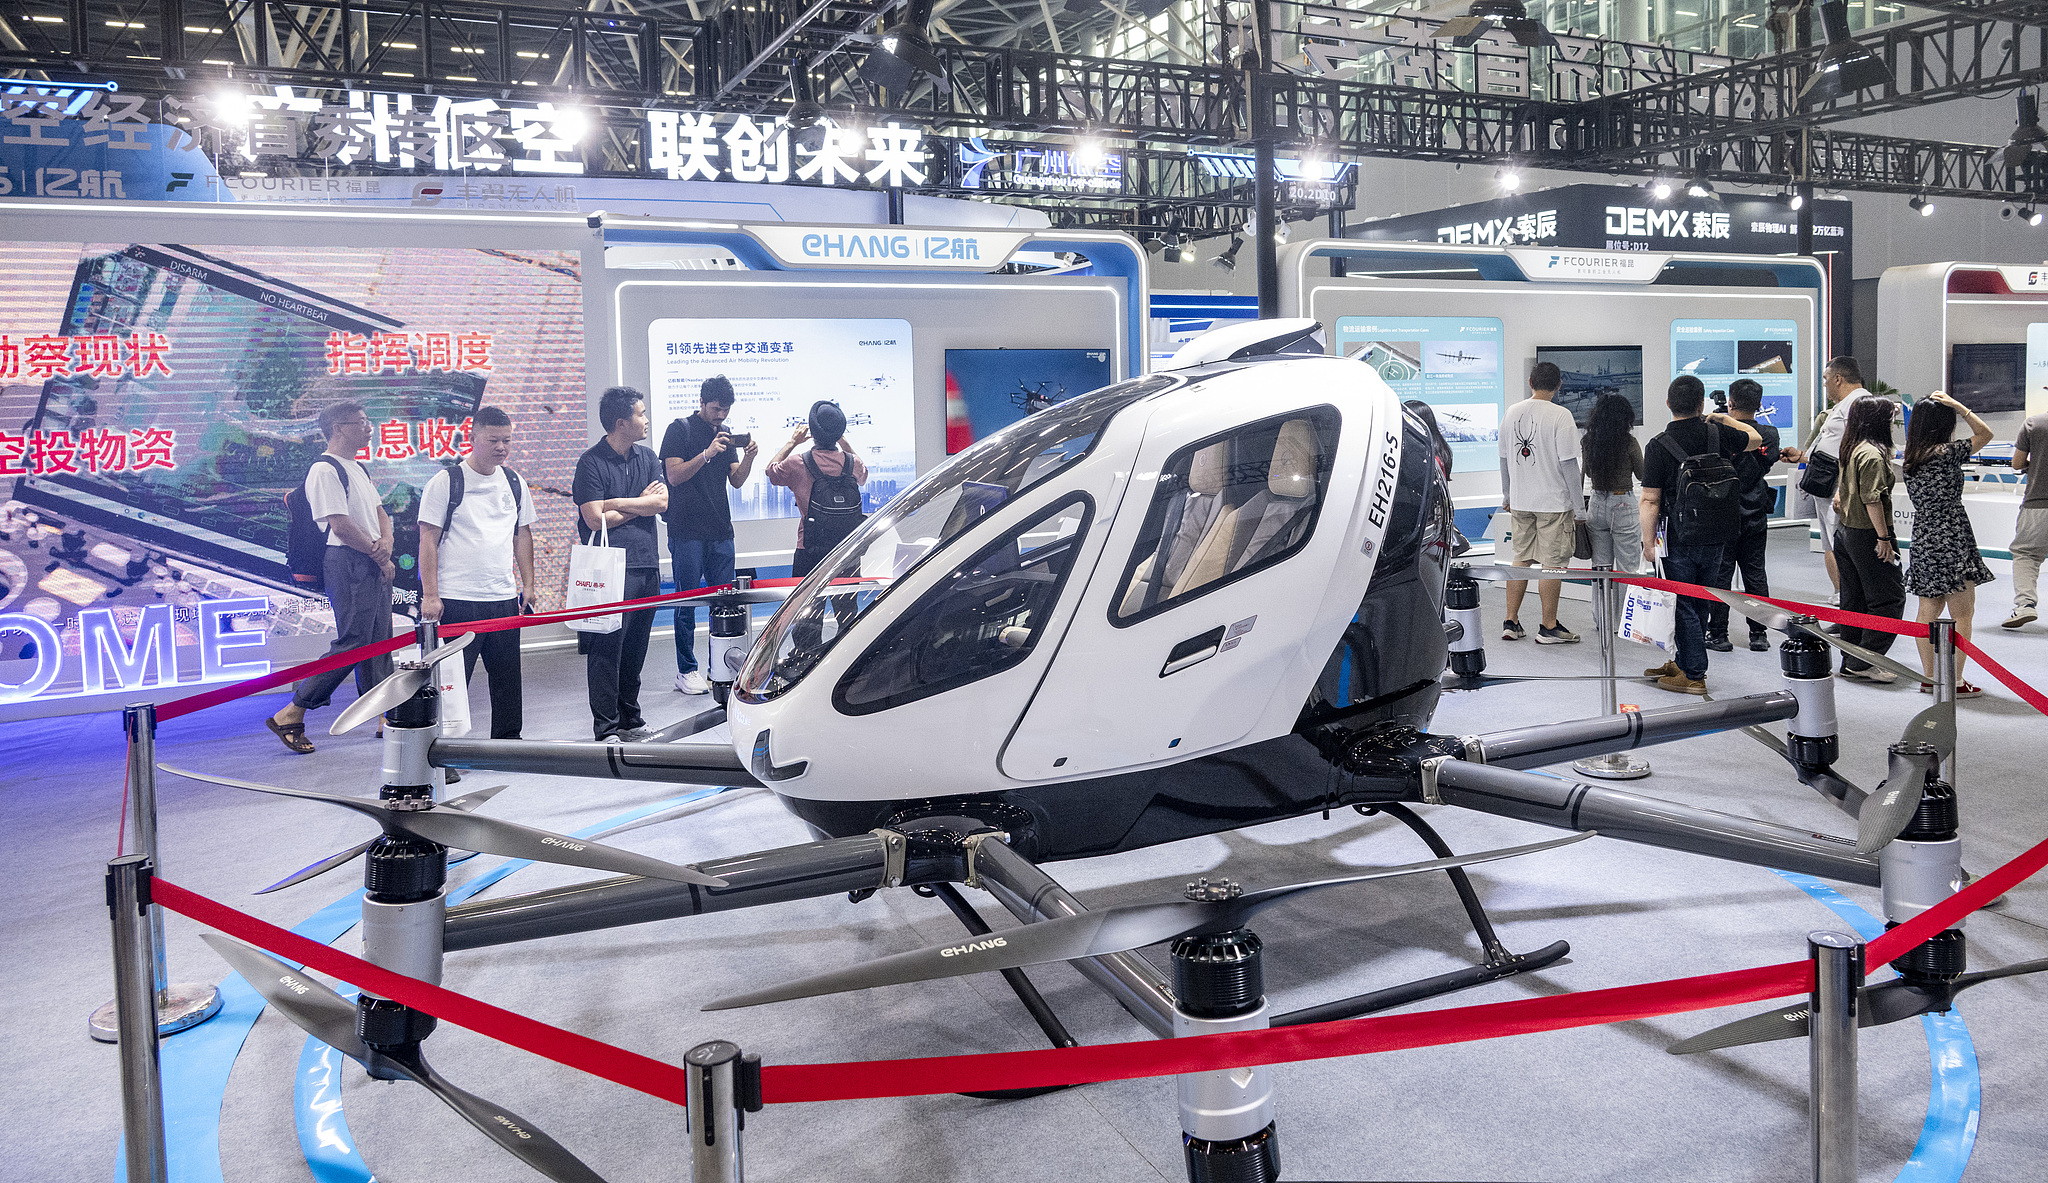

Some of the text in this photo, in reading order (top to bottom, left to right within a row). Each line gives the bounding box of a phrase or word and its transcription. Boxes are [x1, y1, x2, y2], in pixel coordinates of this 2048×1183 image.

[647, 110, 927, 187] 联创未来
[35, 167, 127, 198] 亿航
[205, 175, 381, 194] FCOURIER 福昆
[456, 183, 577, 203] 丰翼无人机
[1517, 209, 1558, 242] 索辰
[1605, 206, 1731, 240] DEMX 索辰
[925, 236, 980, 261] 亿航
[1563, 257, 1618, 268] FCOURIER
[170, 260, 208, 281] DISARM
[260, 291, 329, 322] NO HEARTBEAT
[326, 331, 493, 373] 指挥调度
[666, 341, 794, 355] 引领先进空中交通变革
[667, 358, 689, 366] Leading
[701, 357, 728, 365] Advanced
[738, 357, 760, 366] Mobility
[761, 356, 790, 364] Revolution
[0, 428, 175, 475] 空投物资
[1368, 431, 1399, 530] EH216-S
[1624, 593, 1635, 638] JOIN US
